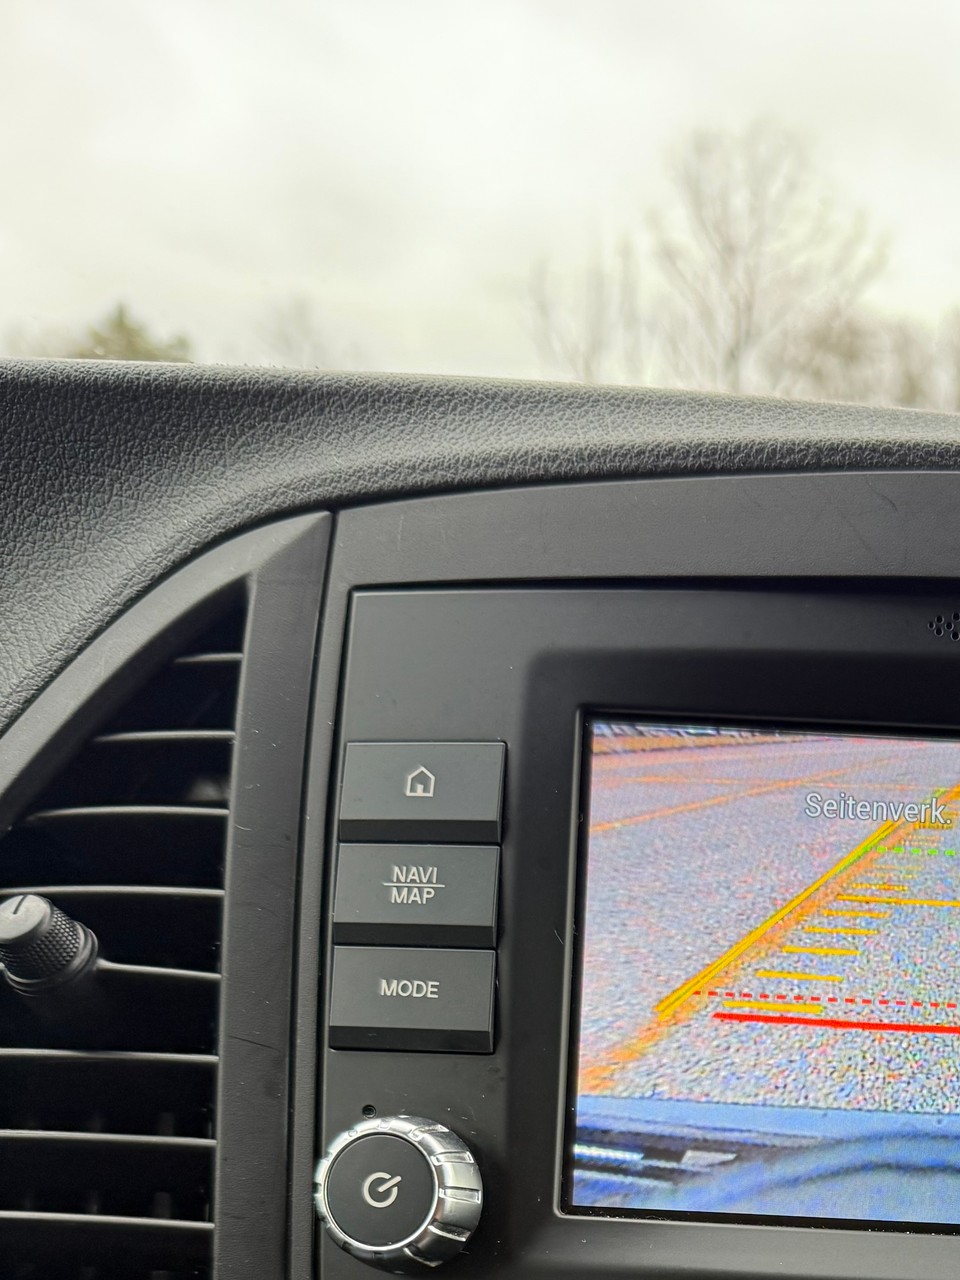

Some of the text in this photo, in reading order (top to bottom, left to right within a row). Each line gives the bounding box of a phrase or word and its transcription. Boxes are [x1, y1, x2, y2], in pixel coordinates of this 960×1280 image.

[804, 792, 952, 825] Seitenverk.
[392, 866, 438, 883] NAVI
[391, 887, 435, 904] MAP
[380, 978, 440, 998] MODE
